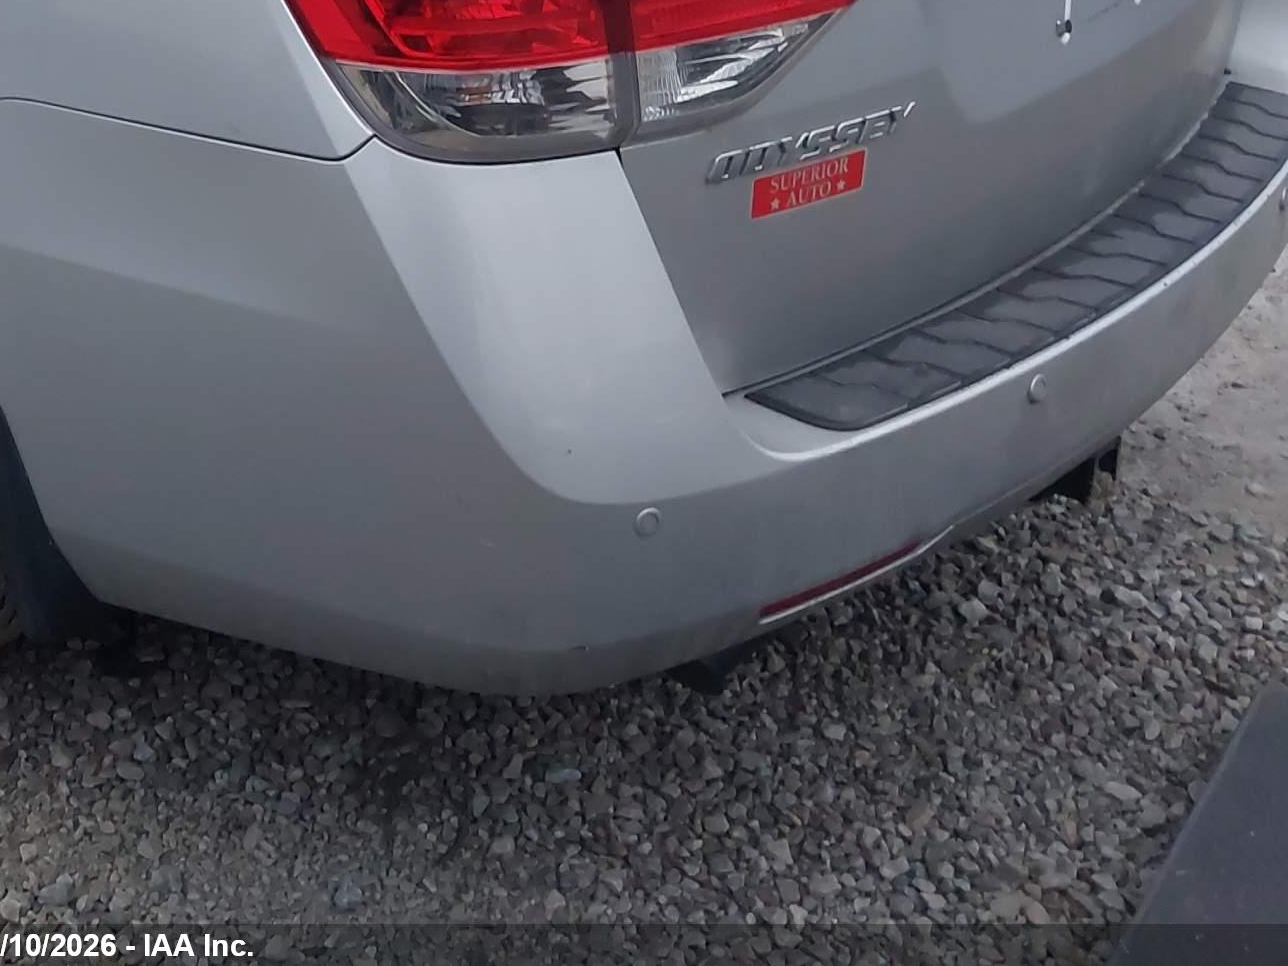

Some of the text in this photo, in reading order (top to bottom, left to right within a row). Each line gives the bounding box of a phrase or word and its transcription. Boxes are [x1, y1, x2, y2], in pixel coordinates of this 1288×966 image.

[705, 100, 917, 185] ODYSSEY
[769, 156, 850, 194] SUPERIOR
[785, 182, 832, 208] AUTO
